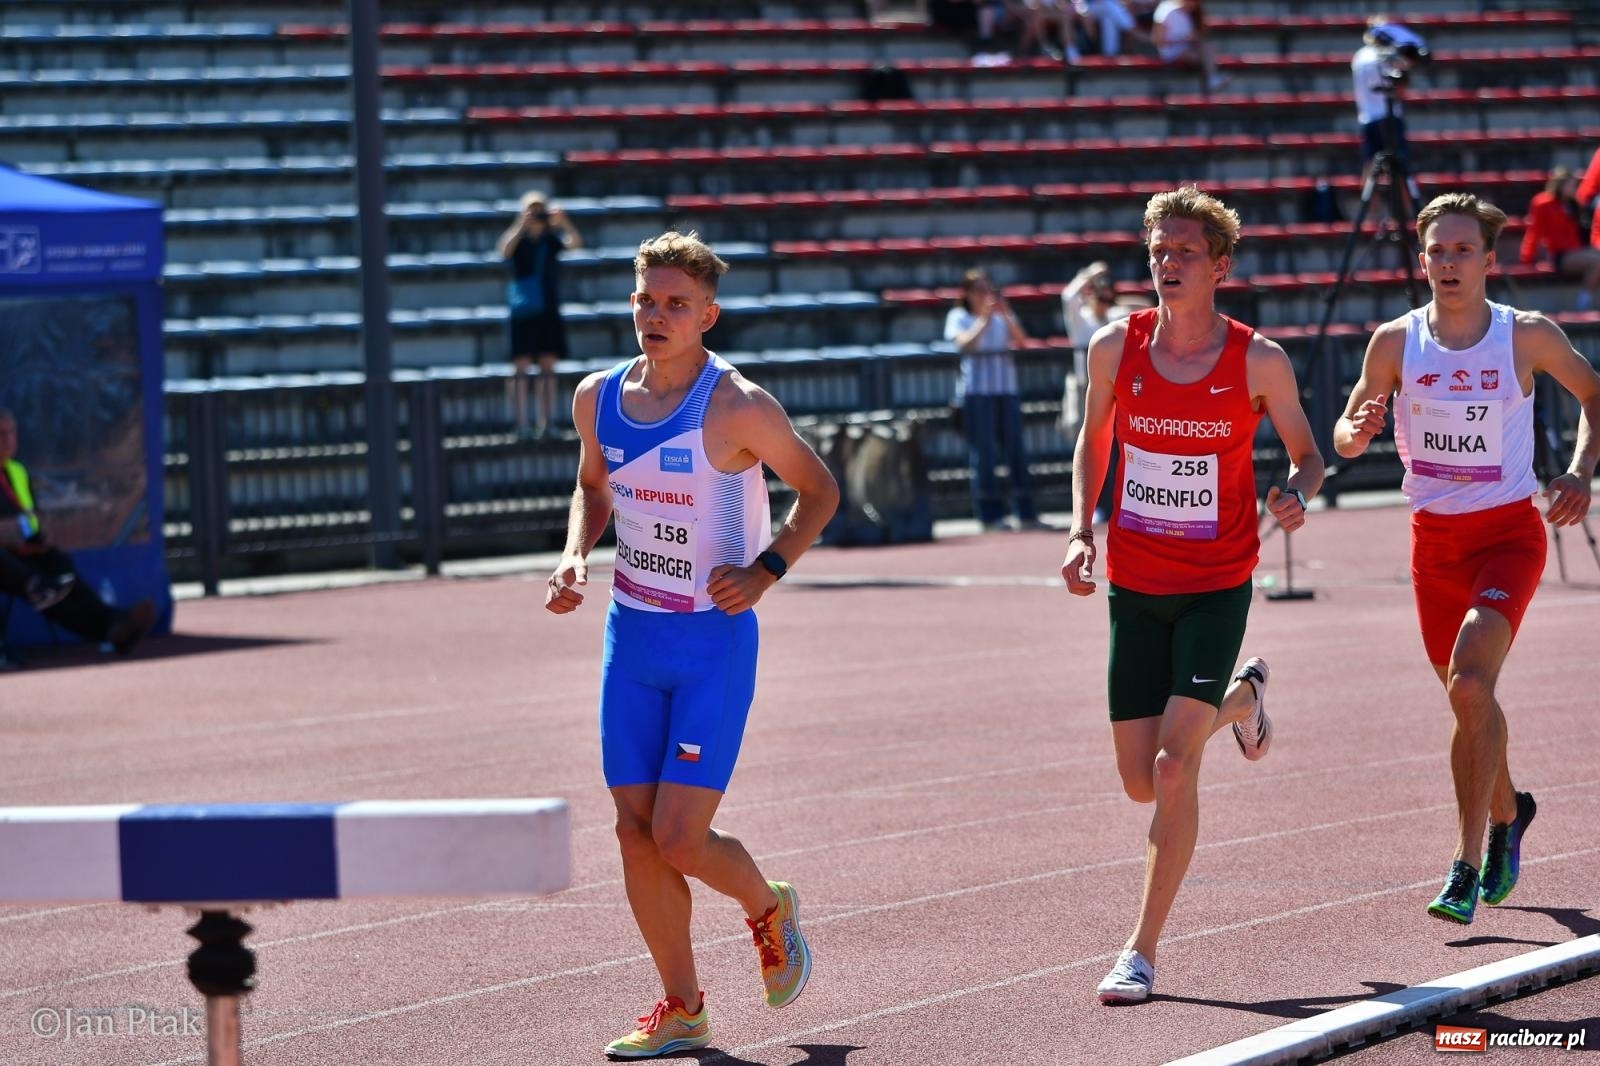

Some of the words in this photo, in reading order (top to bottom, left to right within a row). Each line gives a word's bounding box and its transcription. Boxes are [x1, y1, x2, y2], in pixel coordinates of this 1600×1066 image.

[1416, 373, 1441, 386] 4F
[1465, 405, 1489, 421] 57
[1128, 414, 1232, 438] MAGYARORSZÁG
[1423, 431, 1487, 453] RULKA
[1171, 460, 1209, 476] 258
[635, 488, 694, 507] REPUBLIC
[1126, 479, 1213, 508] GORENFLO
[653, 522, 688, 544] 158
[783, 918, 801, 967] HOKA
